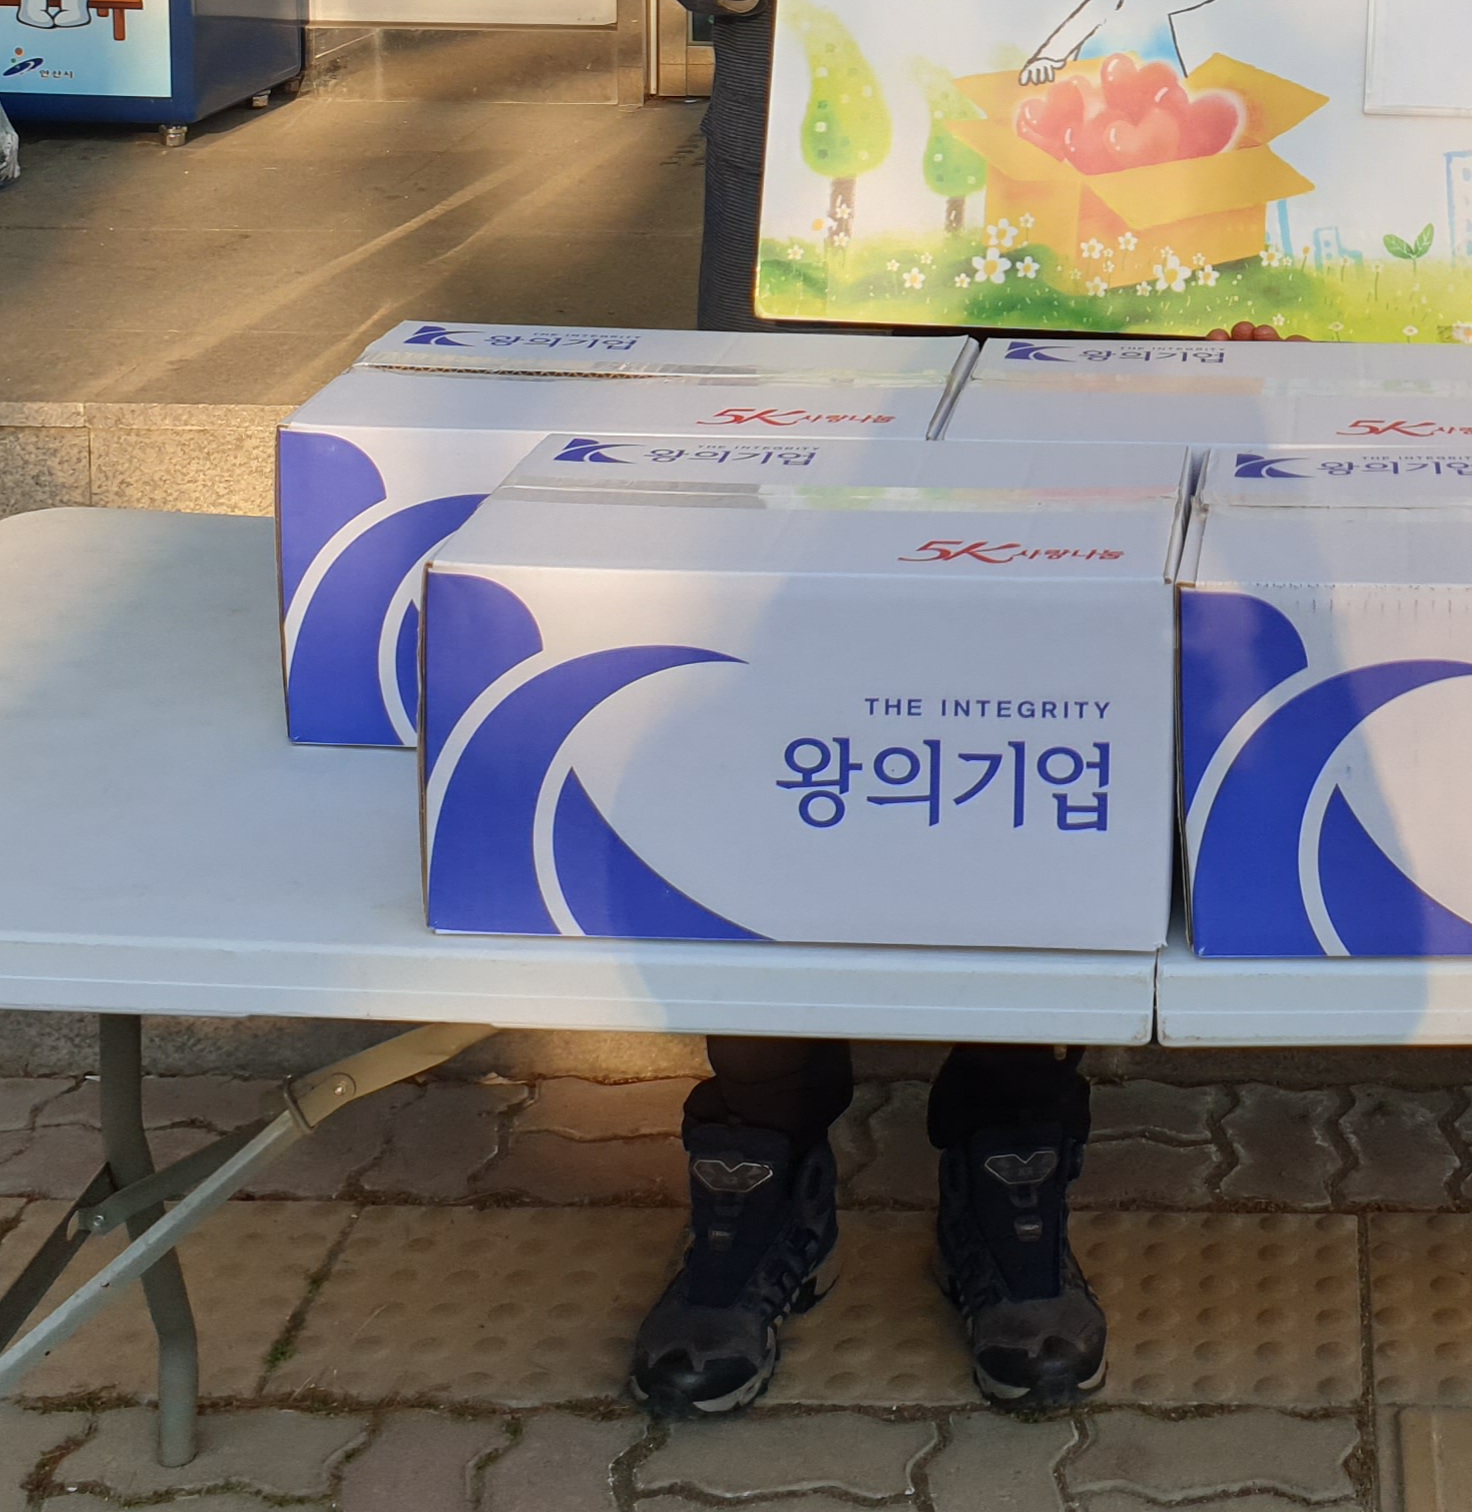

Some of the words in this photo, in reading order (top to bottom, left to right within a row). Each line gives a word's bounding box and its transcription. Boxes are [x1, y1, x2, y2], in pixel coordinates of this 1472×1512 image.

[484, 335, 638, 350] 왕의기업
[1079, 349, 1226, 363] 왕의기업
[644, 448, 818, 466] 왕의기업
[865, 697, 923, 716] THE
[941, 699, 1111, 719] INTEGRITY
[775, 737, 1111, 832] 왕의기업
